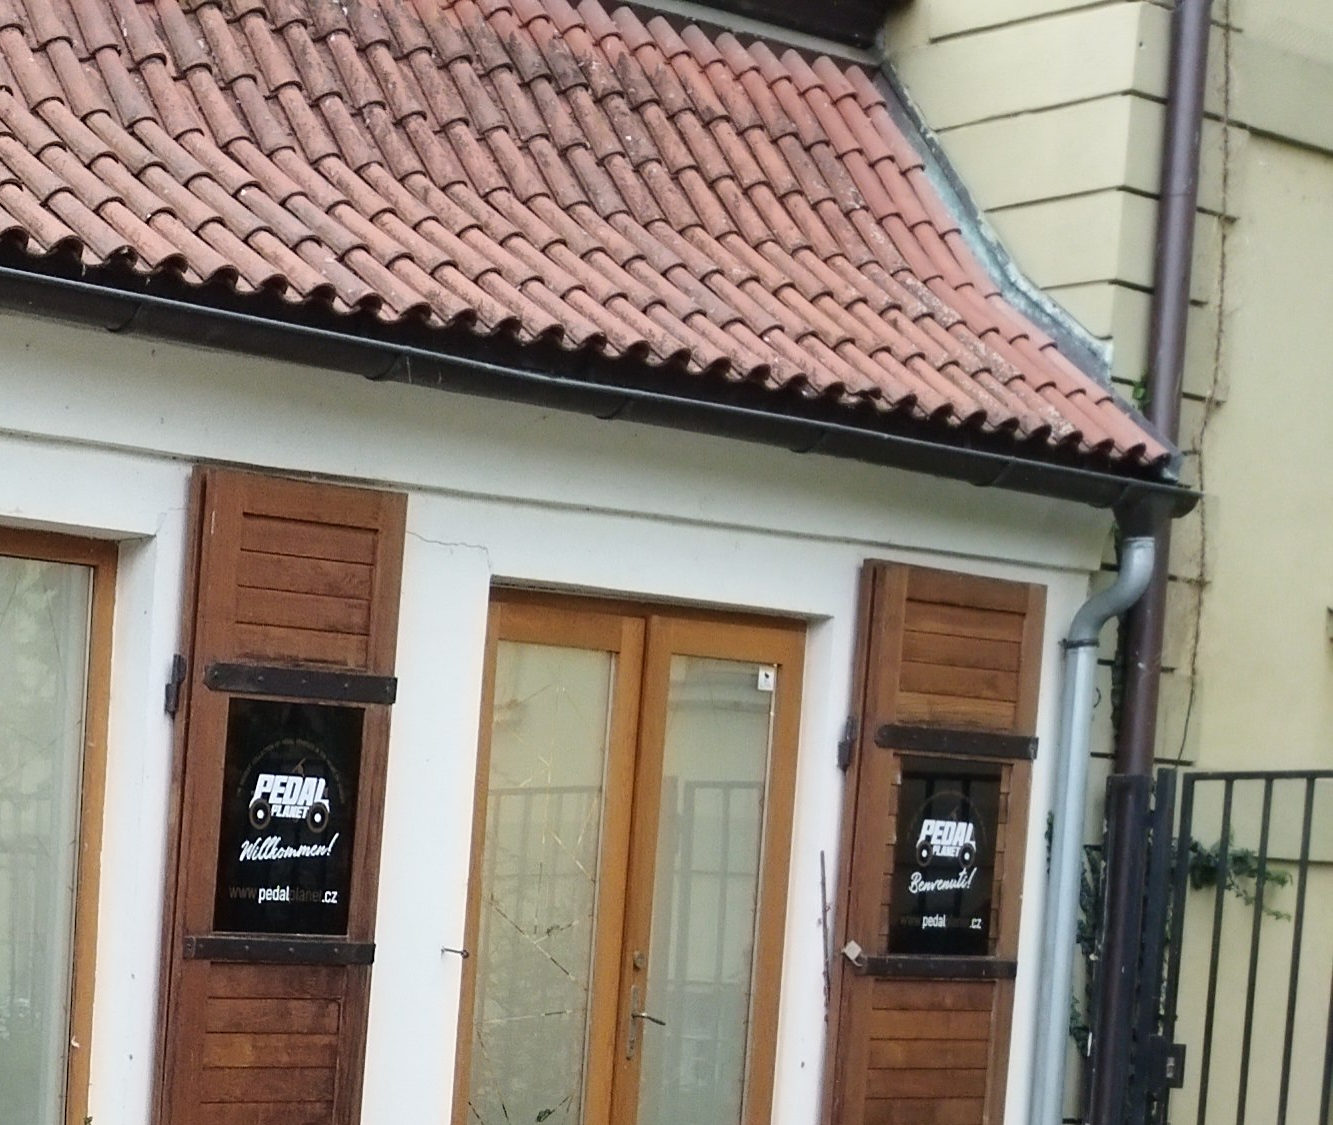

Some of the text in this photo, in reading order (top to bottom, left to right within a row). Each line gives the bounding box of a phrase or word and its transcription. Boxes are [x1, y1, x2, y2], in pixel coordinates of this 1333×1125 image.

[249, 773, 330, 810] PEDAL
[270, 805, 311, 820] PLANET
[239, 832, 339, 862] Willkommen!
[916, 819, 976, 849] PEDAL
[932, 845, 961, 858] PLANET
[909, 866, 977, 893] Benvenuti!
